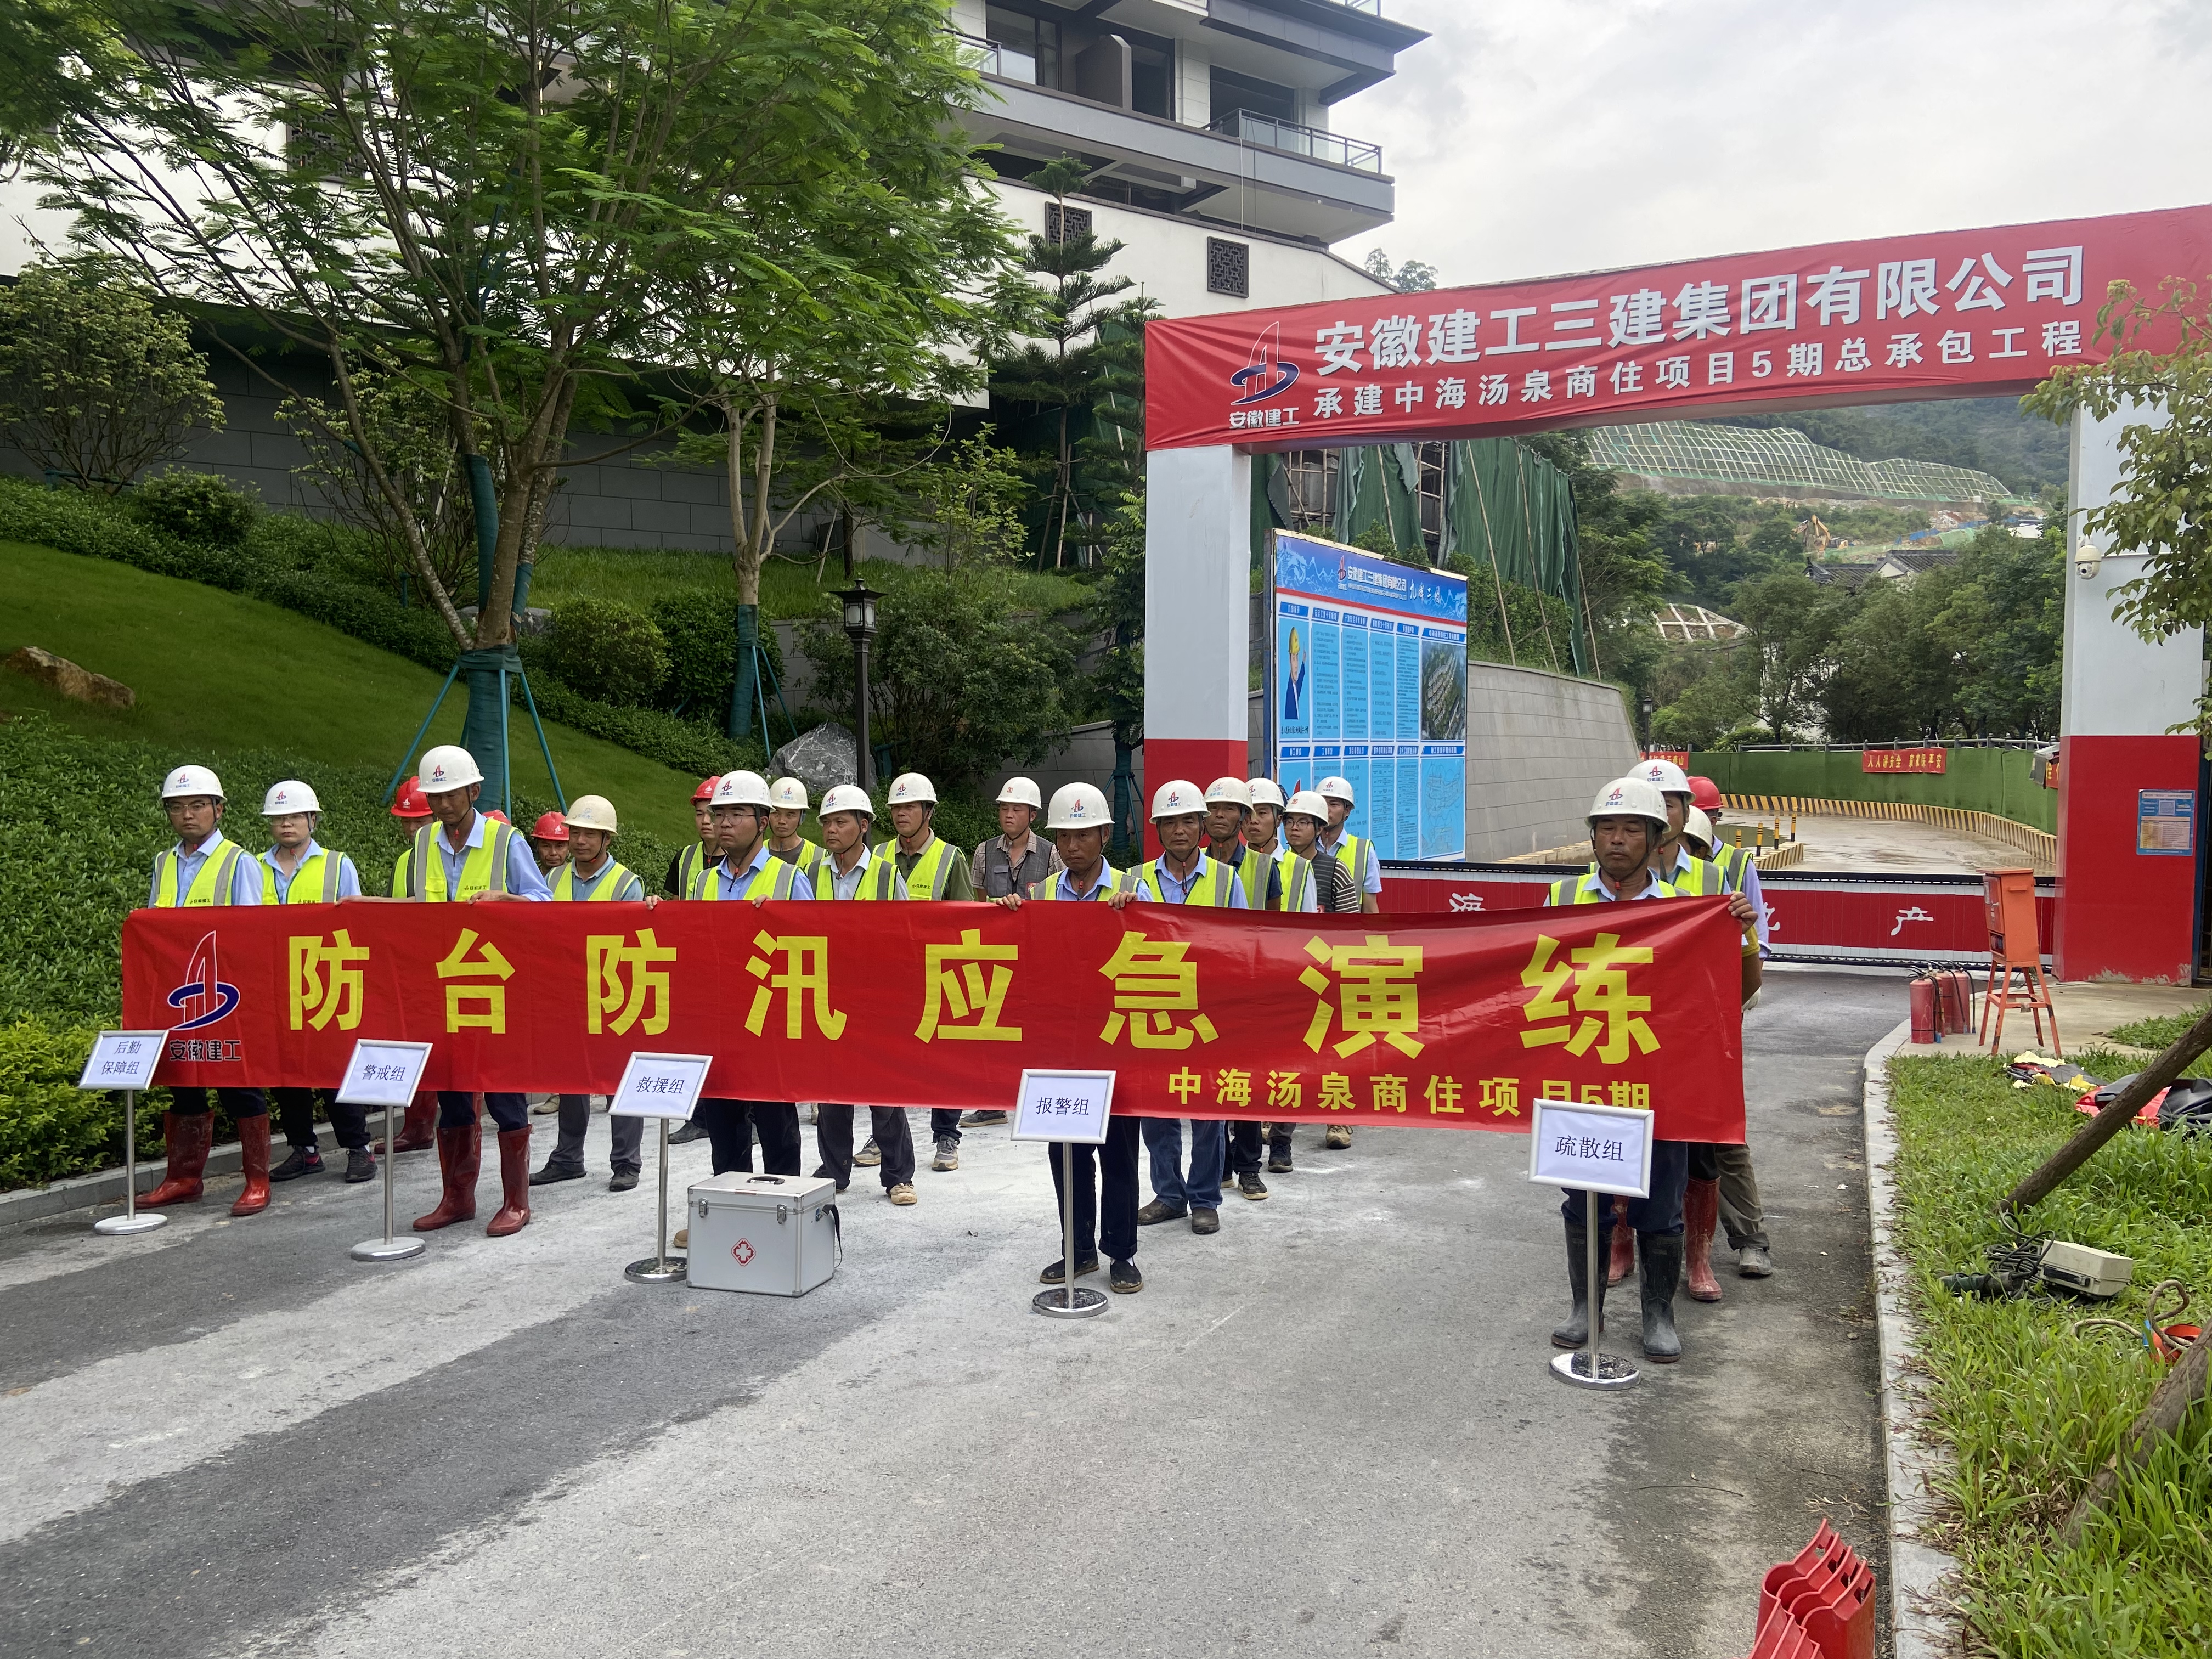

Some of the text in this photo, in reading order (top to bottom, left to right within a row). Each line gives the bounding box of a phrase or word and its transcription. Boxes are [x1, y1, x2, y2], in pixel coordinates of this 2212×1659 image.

[1314, 245, 2083, 376] 安徽建工三建集团有限公司
[1313, 320, 2082, 419] 承建中海汤泉商住项目5期总承包工程
[1229, 407, 1300, 429] 安徽建工
[1891, 906, 1934, 936] 产
[288, 927, 1661, 1064] 防台防汛应急演练
[114, 1040, 142, 1055] 后勤
[169, 1039, 242, 1062] 安徽建工
[101, 1060, 140, 1075] 保障组
[362, 1064, 406, 1081] 警戒组
[636, 1076, 685, 1094] 救援组
[1035, 1097, 1089, 1115] 报警组
[1555, 1135, 1624, 1161] 疏散组
